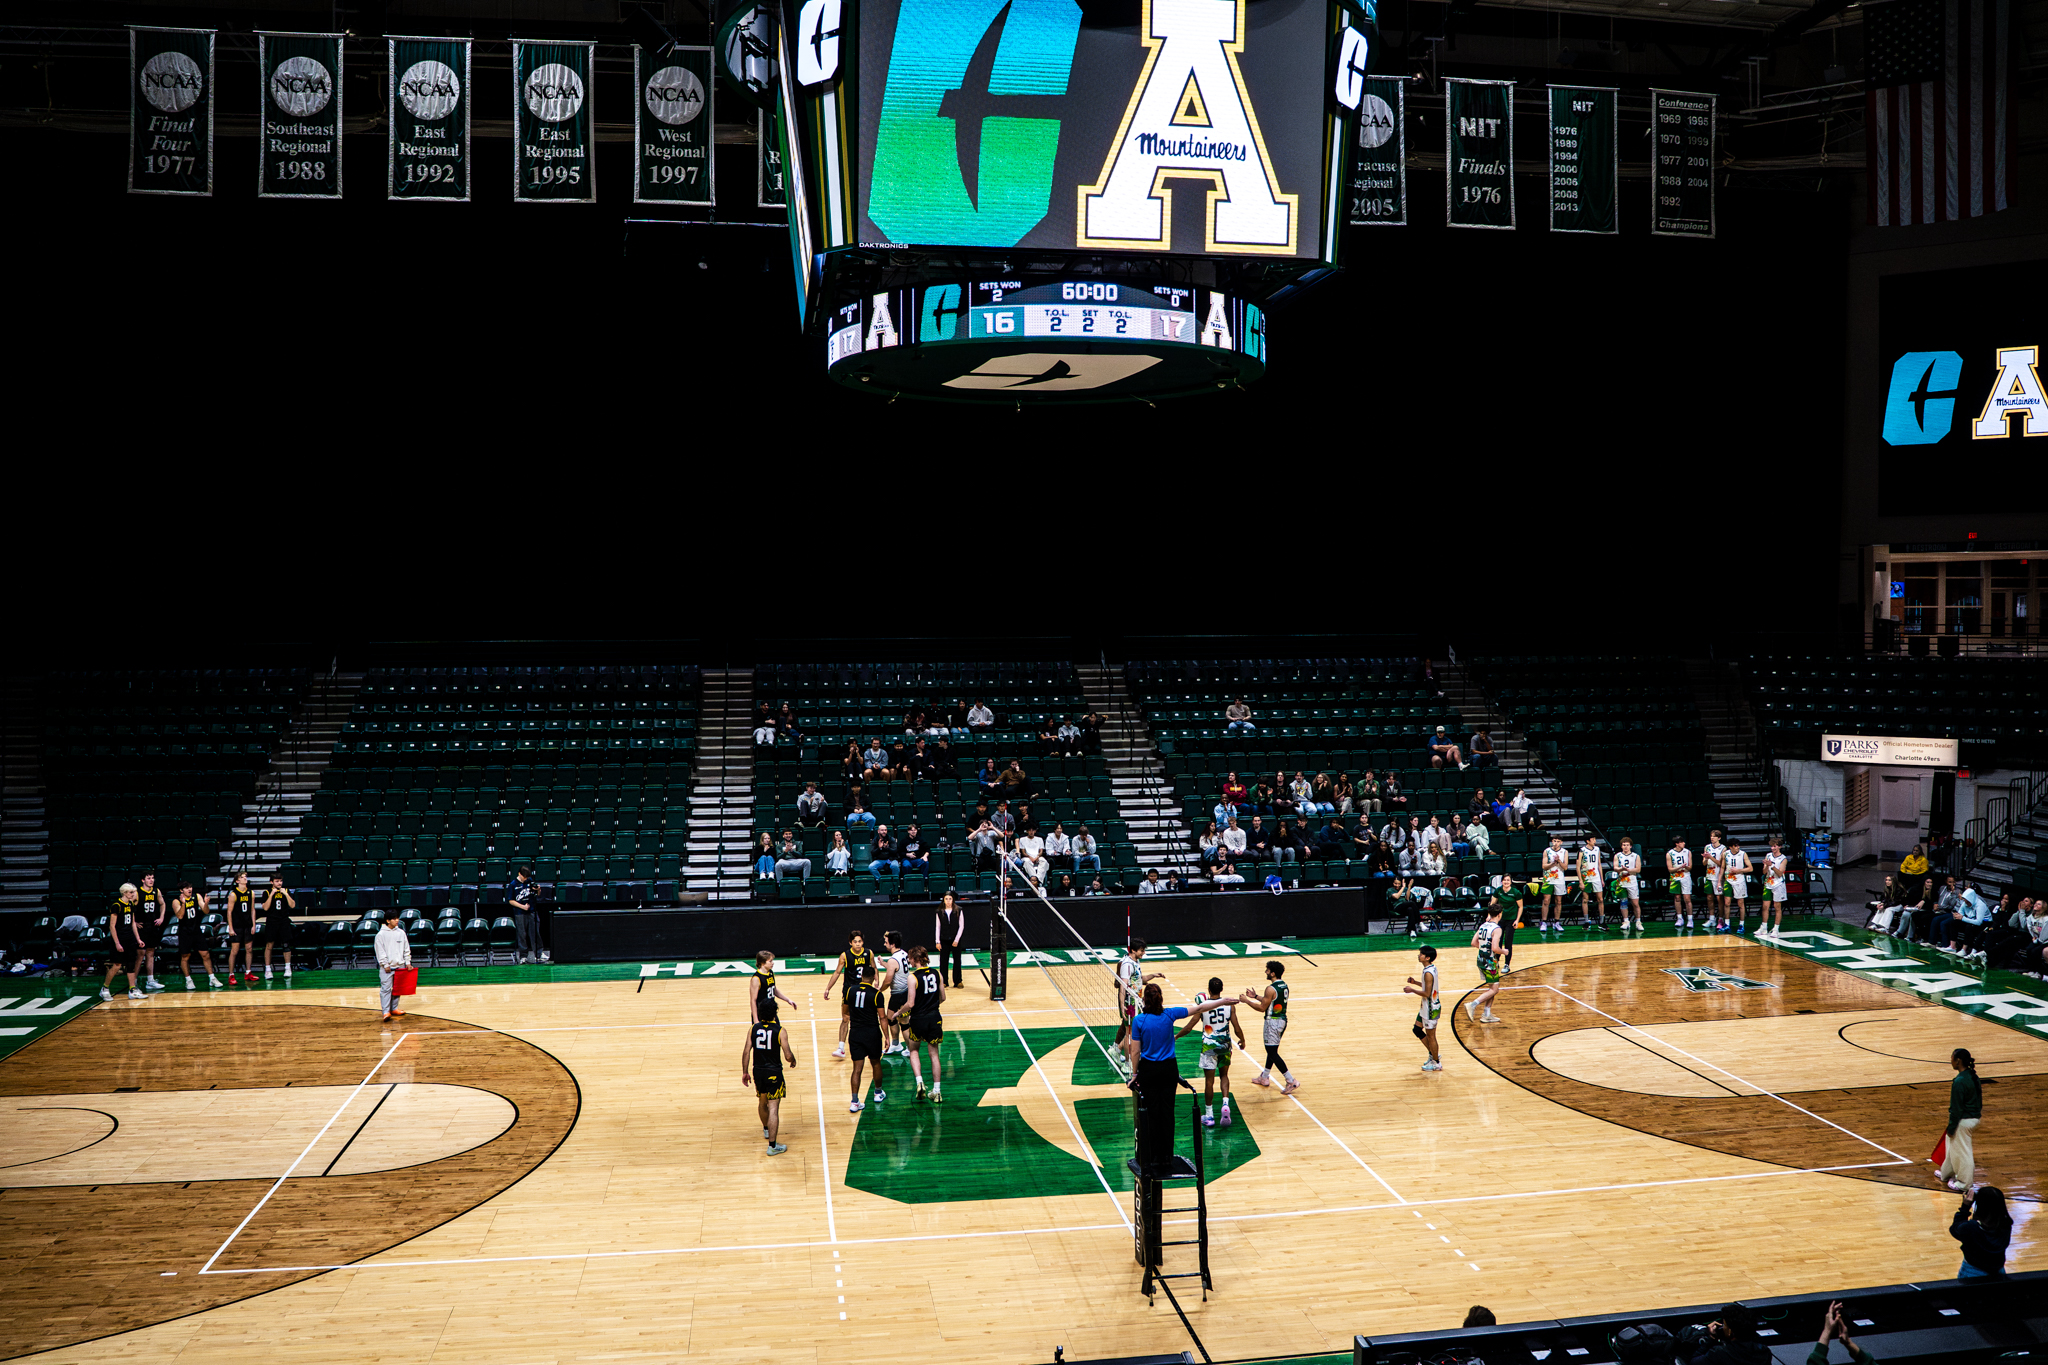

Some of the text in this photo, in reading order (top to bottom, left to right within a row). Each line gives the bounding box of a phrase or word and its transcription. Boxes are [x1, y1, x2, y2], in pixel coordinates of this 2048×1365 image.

[146, 73, 200, 90] NCAA
[275, 78, 328, 94] NCAA
[403, 82, 456, 97] NCAA
[528, 85, 580, 100] NCAA
[649, 87, 701, 103] NCAA
[1572, 100, 1594, 112] NIT
[1658, 98, 1709, 110] Conference
[148, 115, 195, 133] Final
[1360, 114, 1392, 128] CAA
[1659, 113, 1709, 126] 1969 1995
[266, 121, 335, 136] Southeast
[413, 125, 446, 139] East
[539, 127, 571, 141] East
[1460, 116, 1501, 138] NIT
[1554, 127, 1578, 136] 1976
[657, 128, 692, 143] West
[1660, 134, 1709, 146] 1970 1999
[151, 135, 192, 151] Four
[270, 138, 331, 156] Regional
[1135, 132, 1246, 162] Mountaineers
[1554, 139, 1578, 148] 1989
[399, 142, 459, 159] Regional
[525, 145, 585, 161] Regional
[644, 144, 706, 160] Regional
[1554, 152, 1578, 161] 1994
[144, 154, 196, 175] 1977
[1357, 161, 1398, 172] racuse
[1458, 158, 1506, 176] Finals
[1660, 155, 1709, 167] 1977 2001
[275, 161, 326, 180] 1988
[404, 164, 455, 183] 1992
[530, 166, 581, 185] 1995
[649, 165, 699, 185] 1997
[1554, 165, 1578, 173] 2000
[1354, 177, 1393, 191] egional
[1554, 177, 1578, 186] 2006
[1660, 176, 1708, 187] 1988 2004
[1461, 186, 1502, 204] 1976
[1554, 190, 1578, 199] 2008
[1660, 196, 1681, 206] 1992
[1351, 198, 1394, 216] 2005
[1554, 203, 1578, 211] 2013
[1659, 220, 1709, 231] Champions
[979, 281, 1021, 290] SETS WON
[1062, 283, 1118, 301] 60:00
[1154, 286, 1189, 297] SETS WON
[992, 289, 1003, 302] 2
[1171, 294, 1180, 307] 0
[1045, 309, 1069, 317] T.O.L.
[1108, 311, 1132, 319] T.O.L.
[983, 312, 1015, 334] 16
[1050, 317, 1127, 334] 2 2 2
[1160, 315, 1187, 338] 17
[843, 331, 856, 354] 17
[1995, 397, 2040, 406] Mountaineers
[1830, 741, 1840, 753] P
[1844, 740, 1879, 749] PARKS
[1588, 854, 1596, 863] 10
[1676, 856, 1685, 865] 21
[1731, 858, 1736, 867] 11
[144, 902, 155, 913] 99
[241, 902, 247, 912] 0
[276, 900, 282, 910] 8
[124, 913, 131, 924] 18
[186, 907, 196, 919] 10
[1478, 927, 1488, 941] 20
[1009, 941, 1300, 965] ARENA
[922, 973, 937, 994] 13
[1755, 931, 2048, 1035] CHAR
[767, 985, 775, 999] 20
[1283, 988, 1289, 1003] 9
[855, 991, 866, 1008] 11
[1209, 1008, 1224, 1024] 25
[756, 1029, 773, 1050] 21
